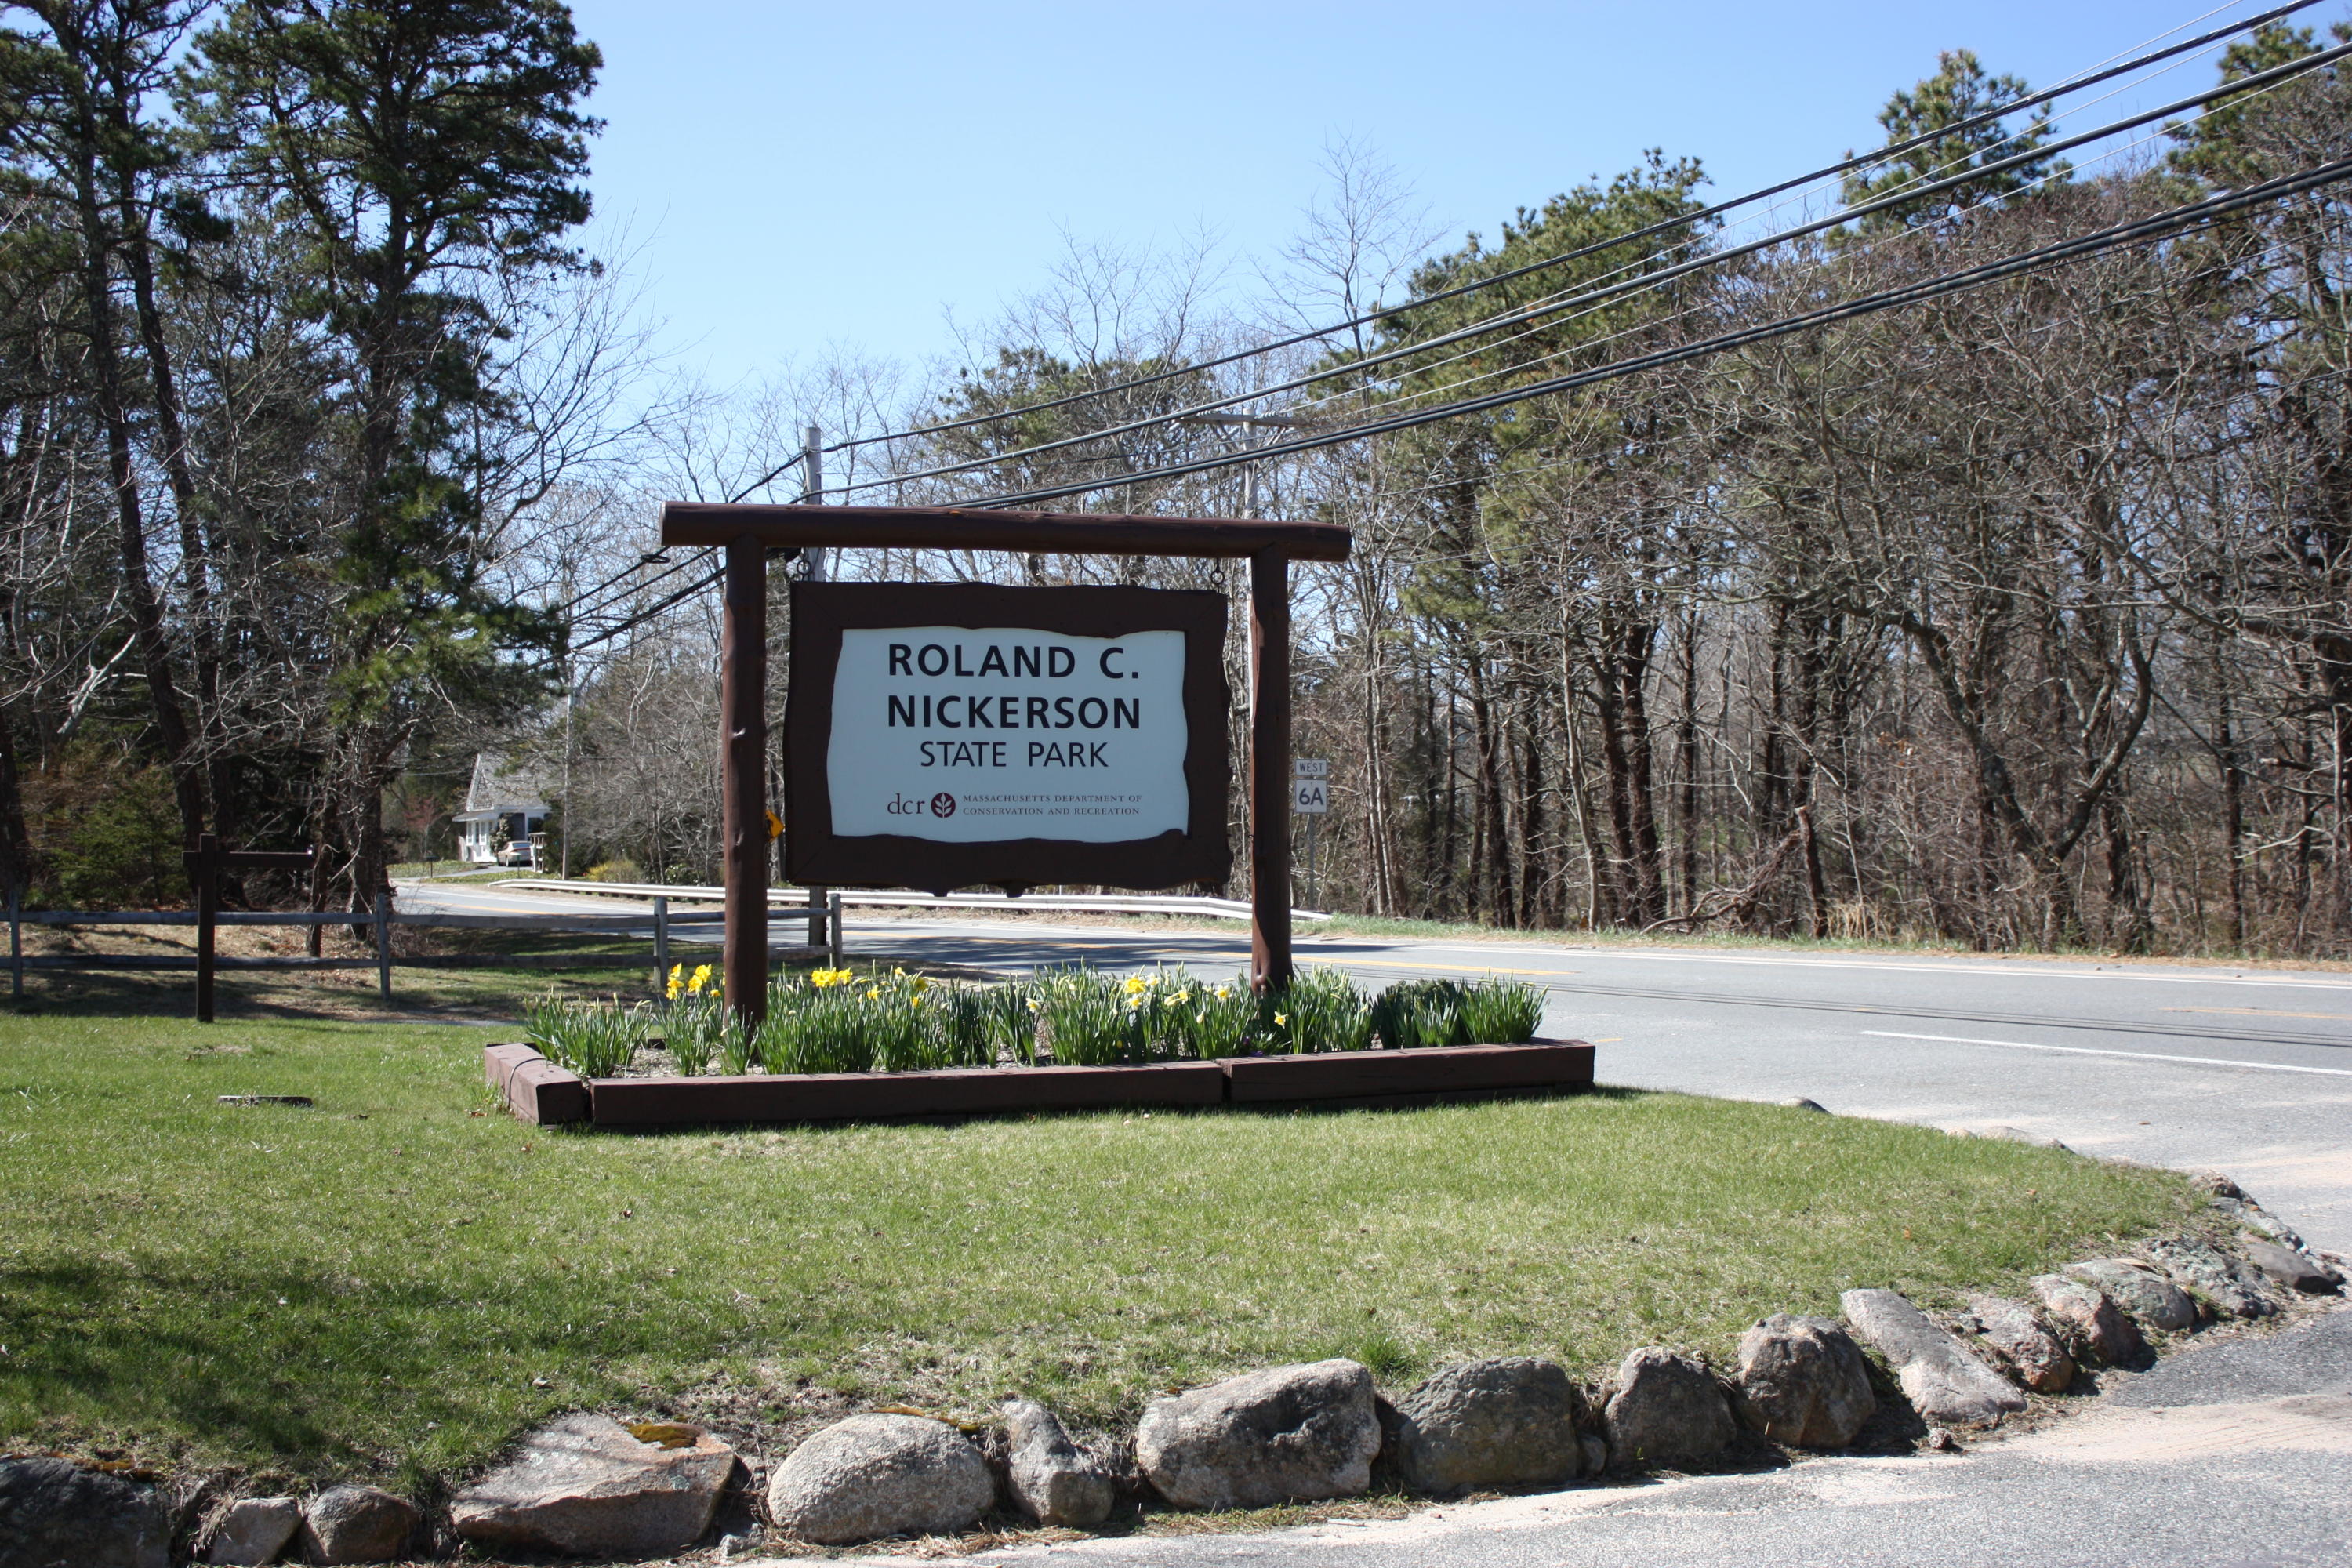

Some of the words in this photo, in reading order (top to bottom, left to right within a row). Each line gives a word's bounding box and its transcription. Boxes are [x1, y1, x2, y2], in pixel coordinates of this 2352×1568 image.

[888, 643, 1076, 678] ROLAND
[1099, 646, 1139, 680] C.
[887, 695, 1140, 729] NICKERSON
[920, 740, 1007, 768] STATE
[1028, 742, 1109, 768] PARK
[1299, 763, 1323, 772] WEST
[887, 793, 926, 815] dcr
[963, 794, 1051, 803] MASSACHUSETTS
[1054, 794, 1124, 803] DEPARTMENT
[1298, 787, 1324, 805] 6A
[963, 807, 1044, 815] CONSERVATION
